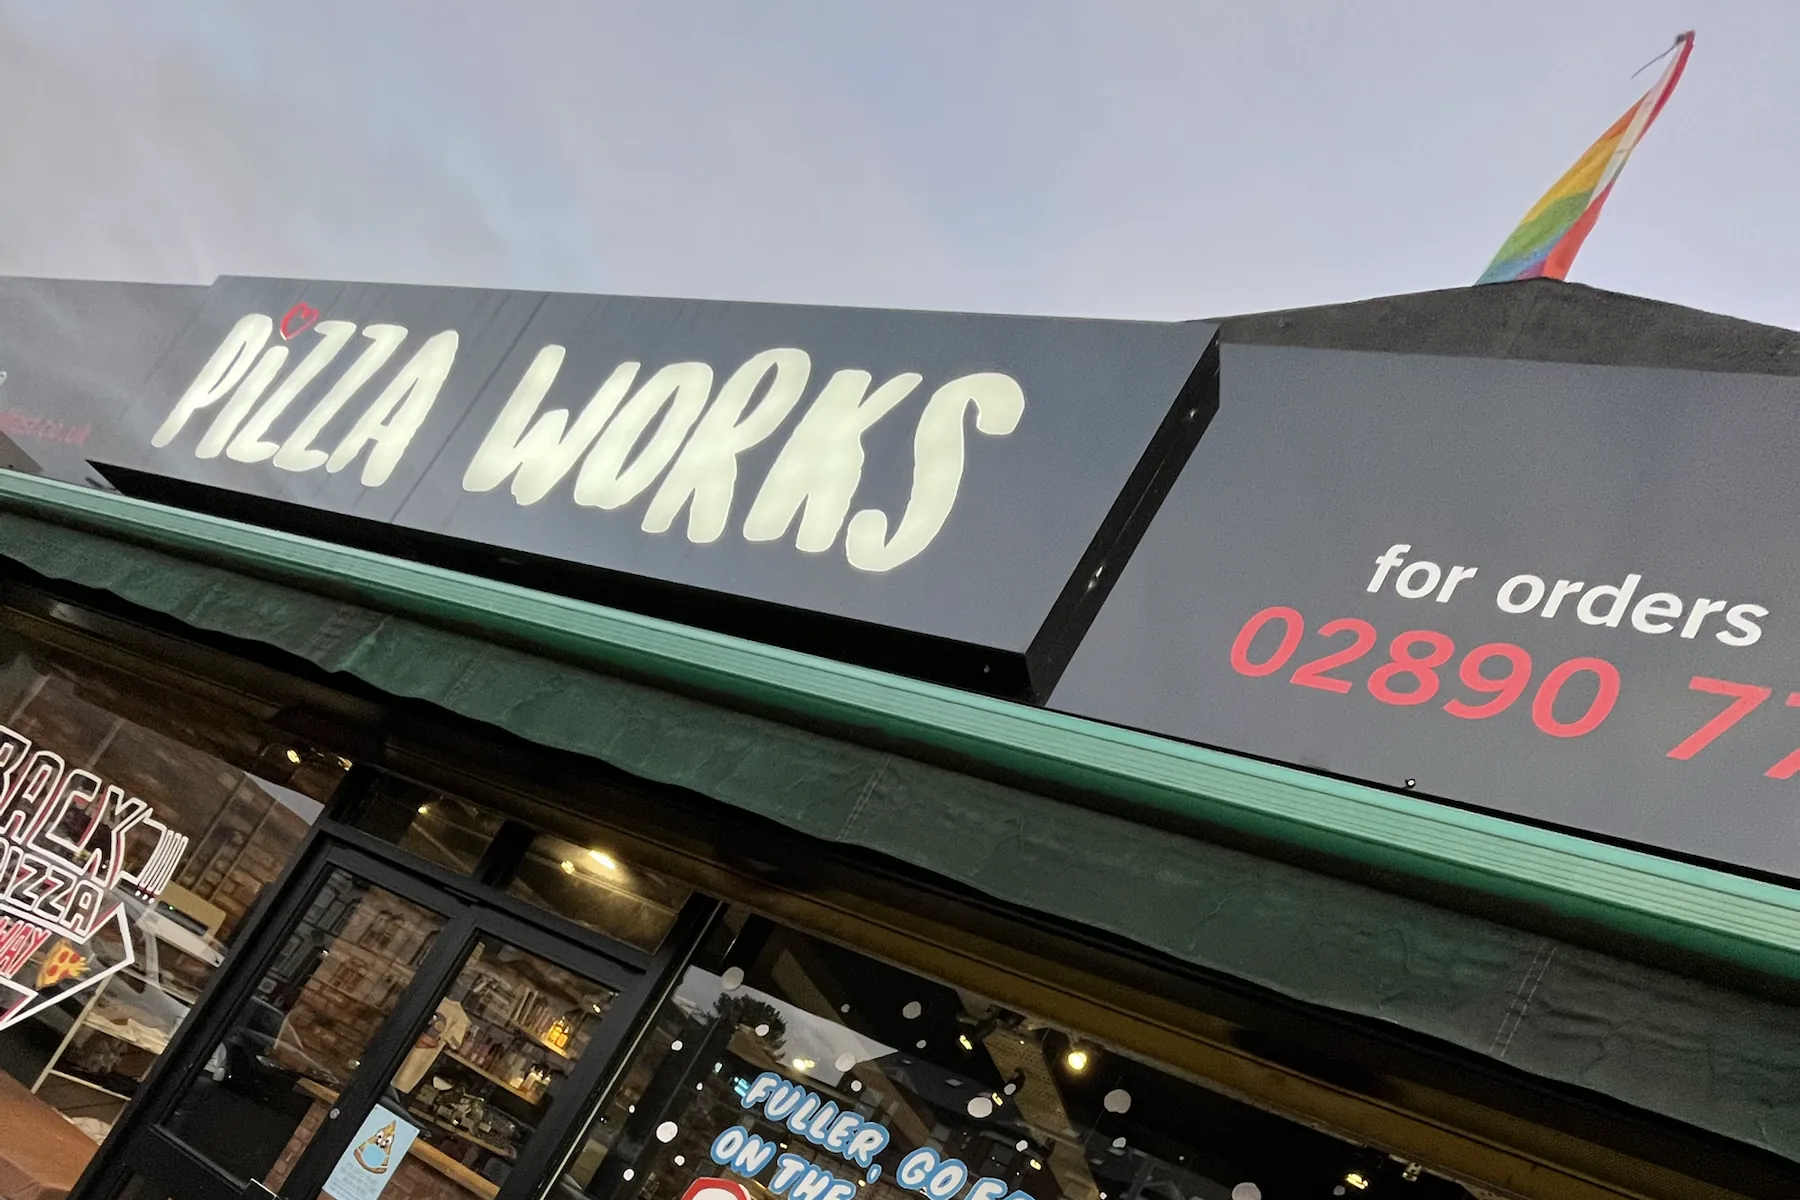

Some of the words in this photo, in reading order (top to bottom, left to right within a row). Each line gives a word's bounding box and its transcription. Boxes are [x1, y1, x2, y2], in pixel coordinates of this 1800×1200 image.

[462, 346, 1026, 572] WORKS
[1366, 543, 1478, 604] for
[1495, 572, 1770, 647] orders
[1229, 605, 1621, 739] 02890
[0, 838, 104, 937] IZZA
[712, 1126, 776, 1177] ON
[742, 1072, 888, 1184] FULLER,
